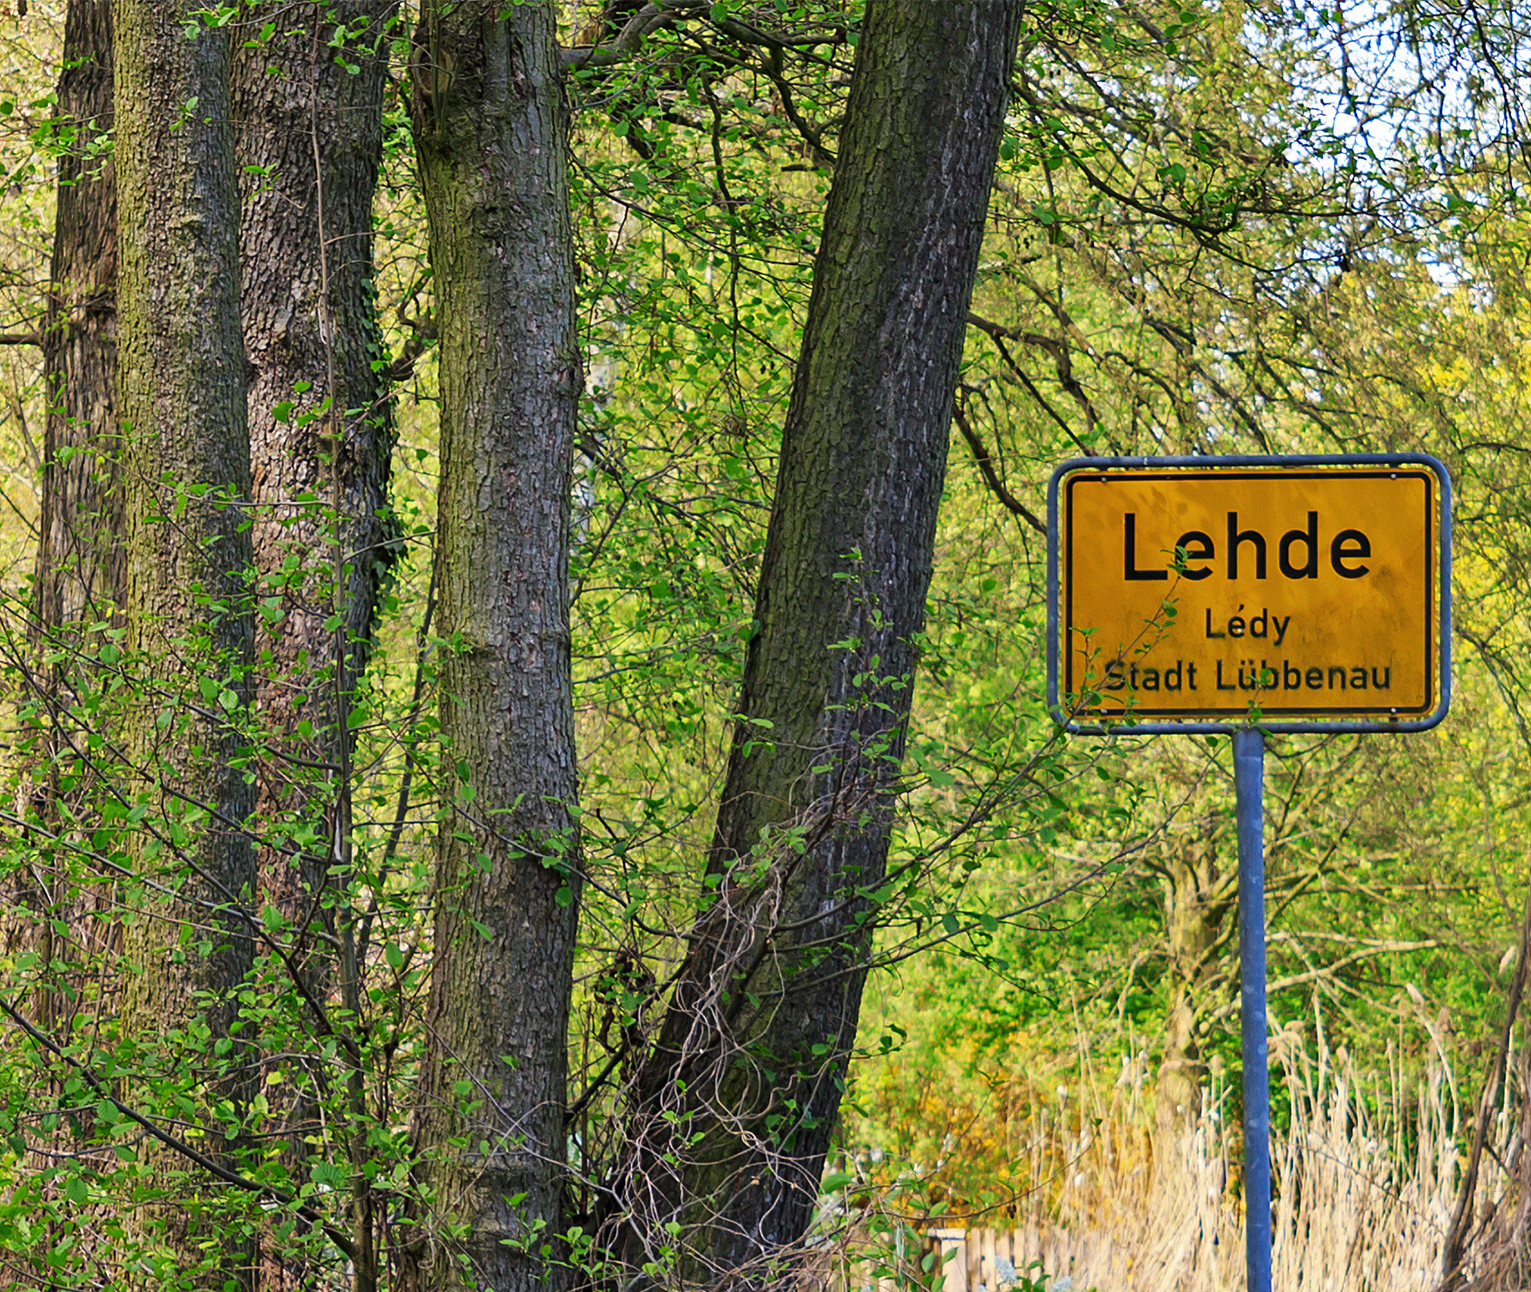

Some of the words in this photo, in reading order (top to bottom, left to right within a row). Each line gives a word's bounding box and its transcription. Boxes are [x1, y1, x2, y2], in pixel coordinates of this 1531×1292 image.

[1124, 511, 1372, 581] Lehde
[1205, 604, 1291, 646] Lédy
[1104, 659, 1198, 692] Stadt
[1216, 658, 1392, 692] Lübbenau
